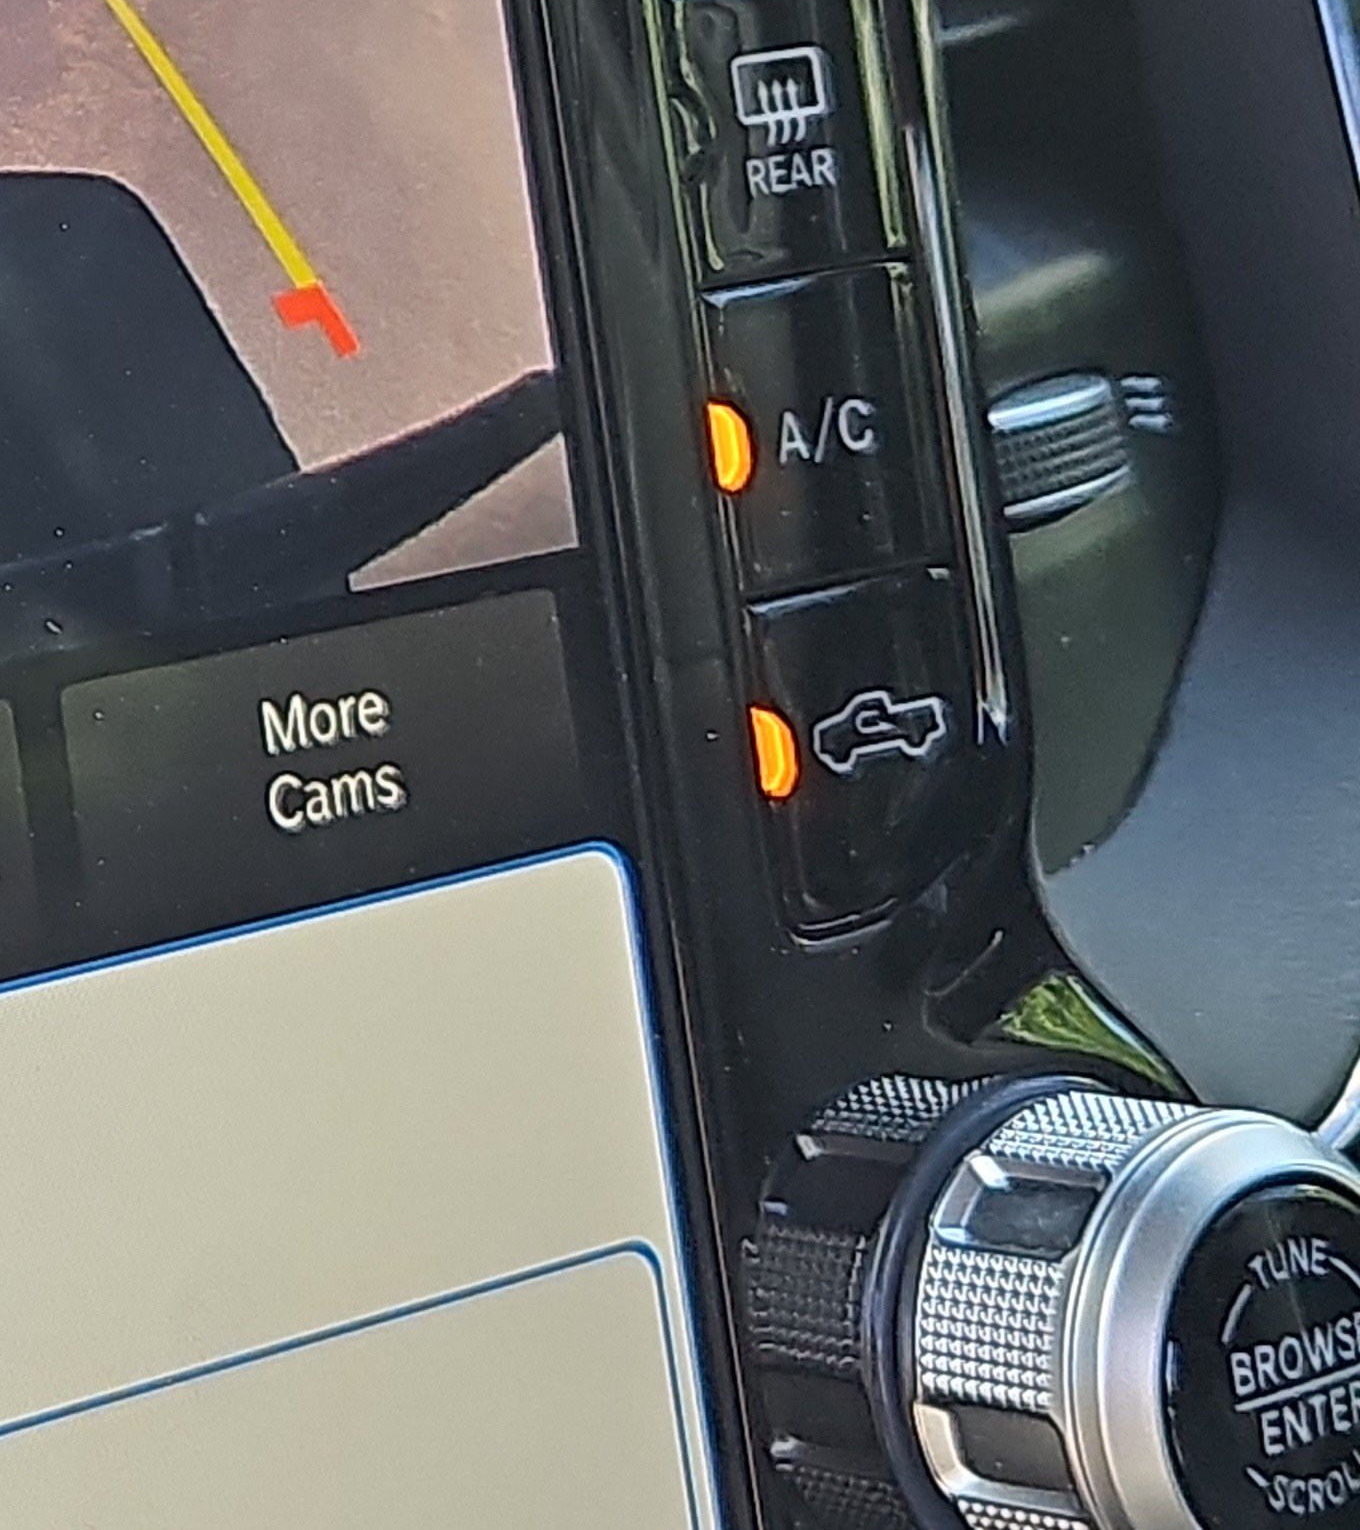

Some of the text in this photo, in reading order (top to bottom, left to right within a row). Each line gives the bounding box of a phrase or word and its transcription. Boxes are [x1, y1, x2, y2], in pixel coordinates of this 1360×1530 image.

[745, 147, 837, 198] REAR
[780, 397, 877, 464] A/C
[261, 690, 391, 757] More
[268, 765, 407, 833] Cams
[1247, 1238, 1330, 1290] TUNE
